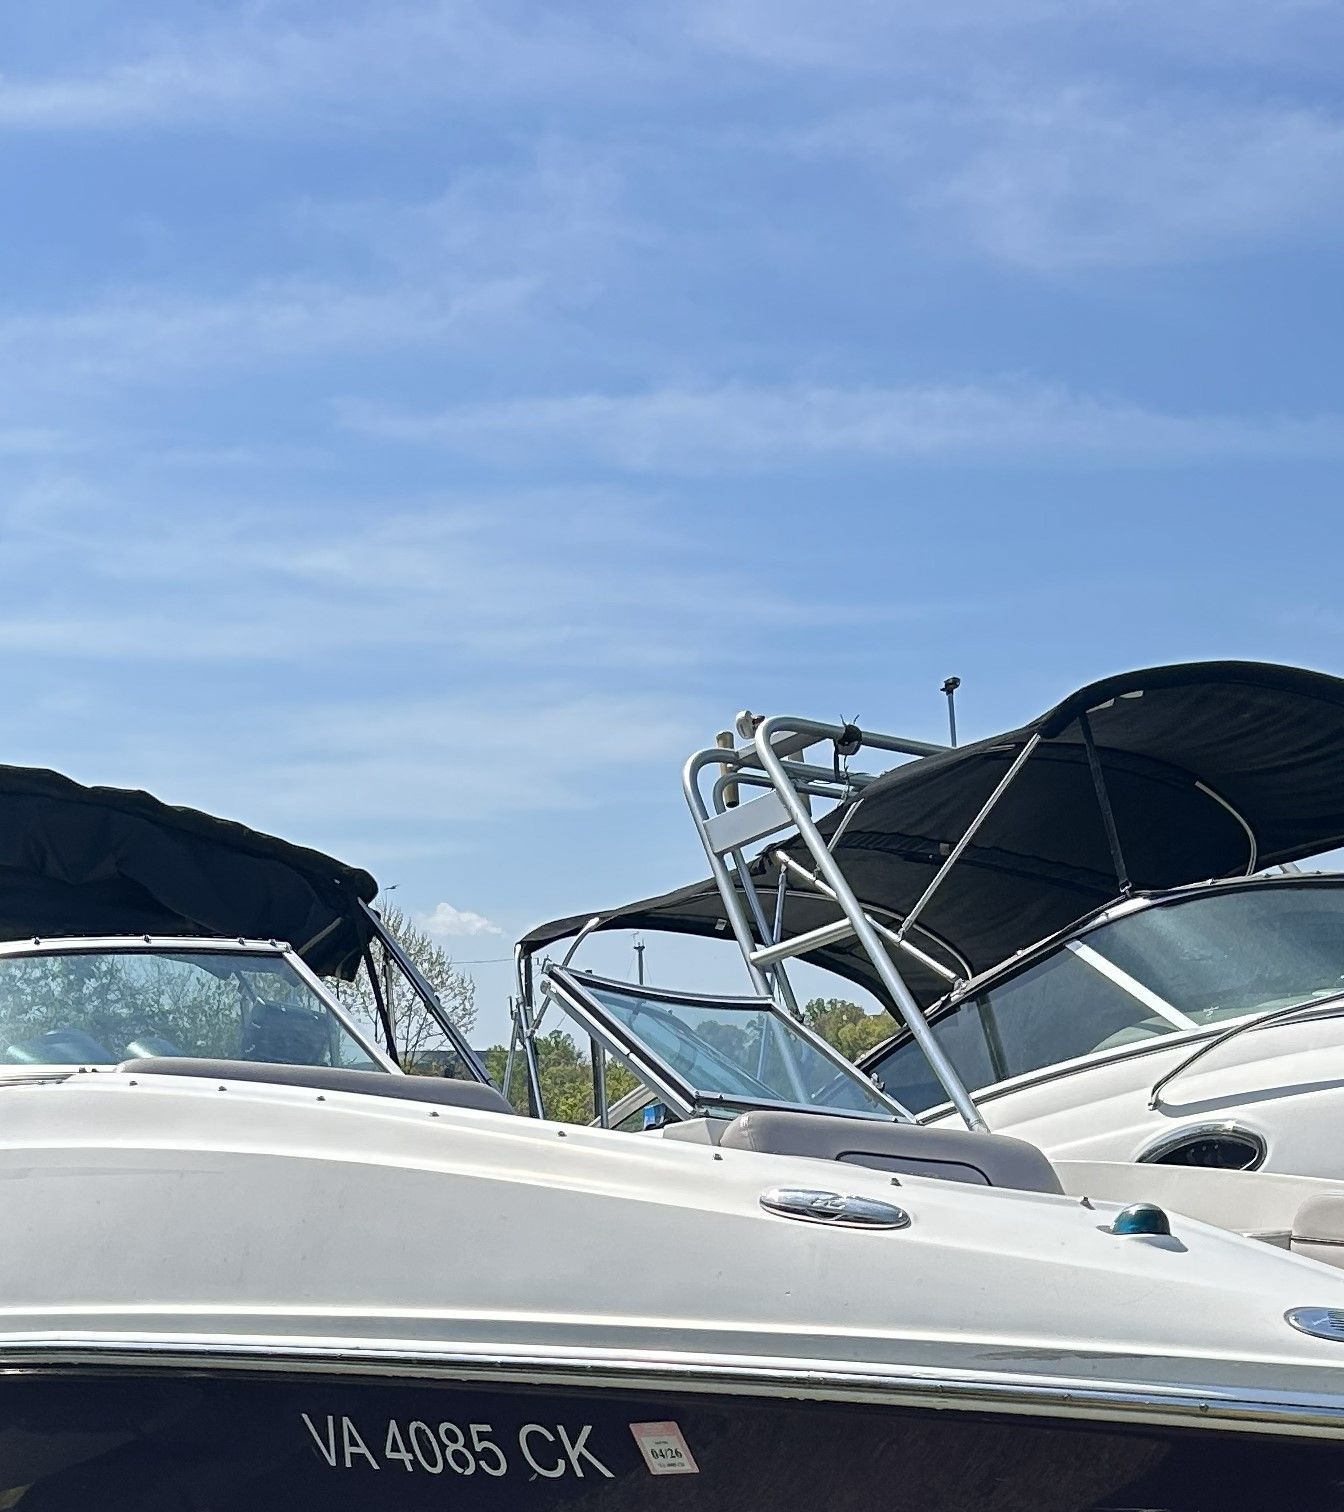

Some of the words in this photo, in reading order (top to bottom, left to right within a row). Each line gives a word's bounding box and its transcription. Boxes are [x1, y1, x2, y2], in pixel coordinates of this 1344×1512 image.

[301, 1412, 381, 1471] VA
[385, 1419, 508, 1478] 4085
[518, 1423, 616, 1480] CK
[650, 1447, 683, 1460] 04/26
